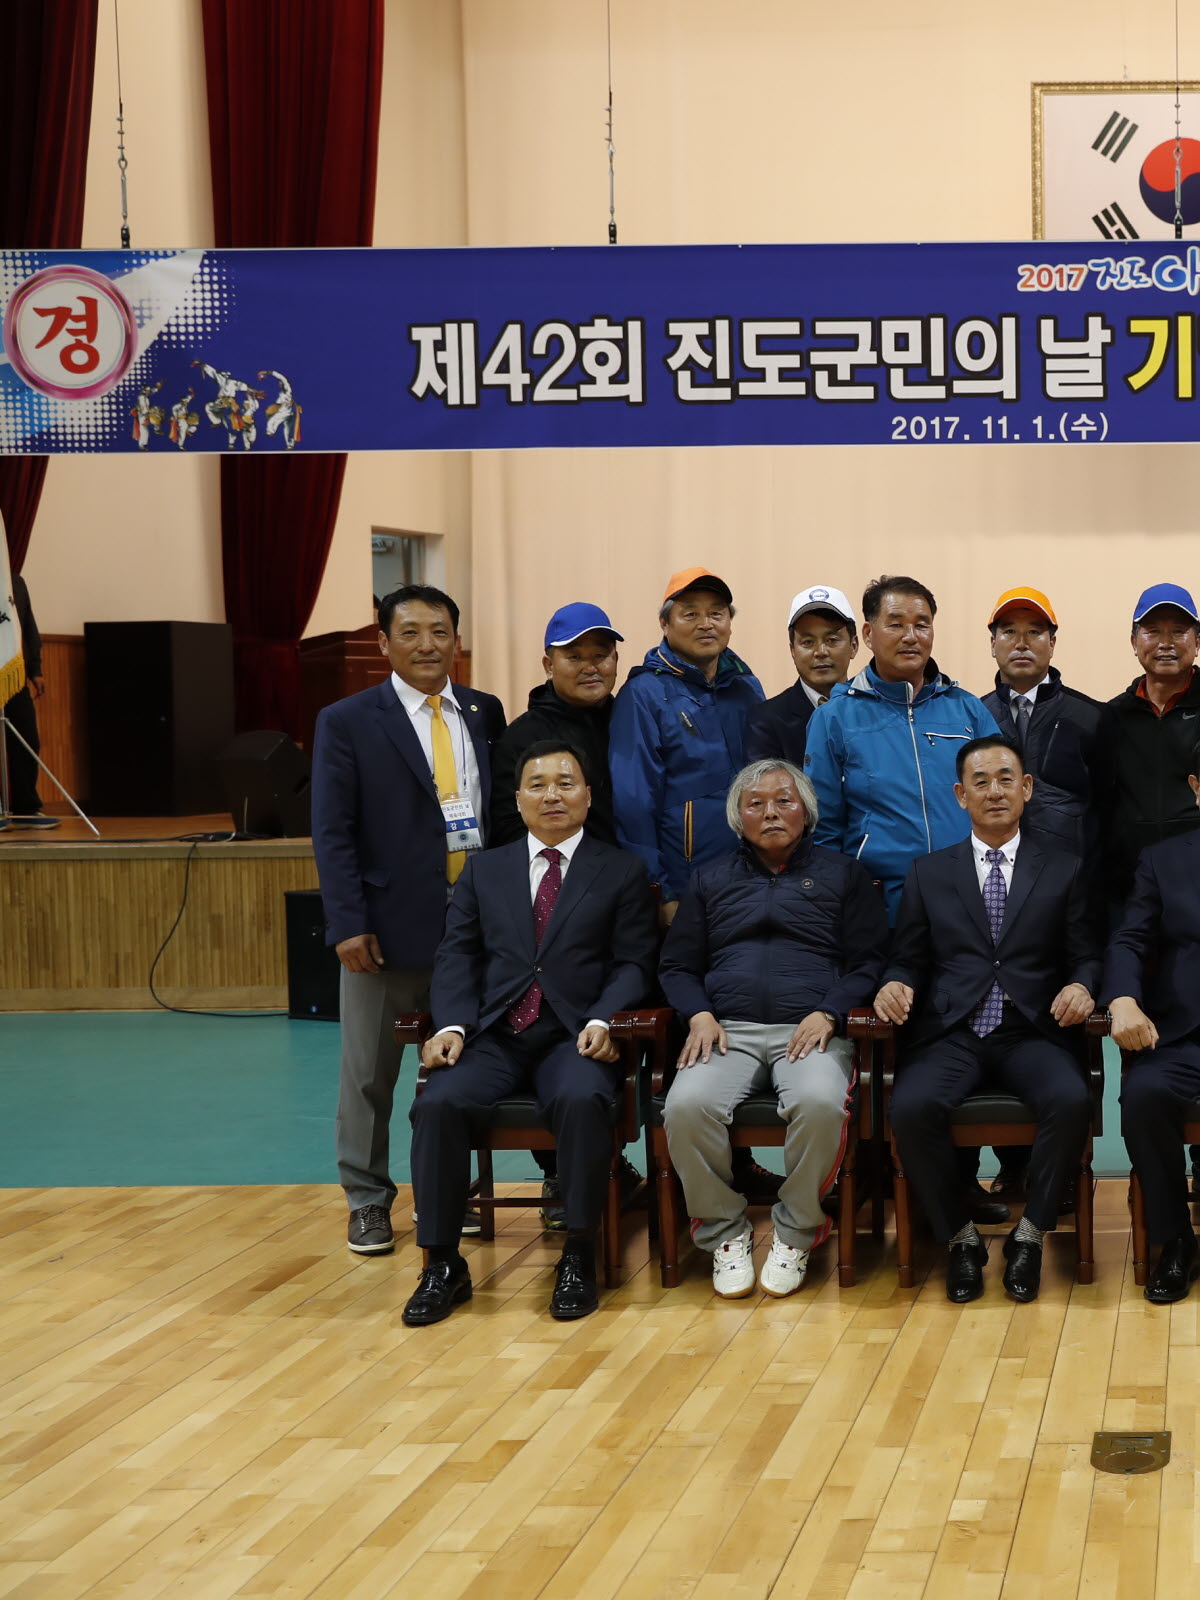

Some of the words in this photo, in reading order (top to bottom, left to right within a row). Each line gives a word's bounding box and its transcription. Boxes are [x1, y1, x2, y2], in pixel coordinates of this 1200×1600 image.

[1018, 265, 1087, 290] 2017
[1090, 257, 1151, 290] 진도
[32, 295, 99, 375] 경
[410, 318, 643, 405] 제42회
[666, 316, 1017, 401] 진도군민의
[1040, 316, 1112, 399] 날
[891, 415, 970, 441] 2017.
[982, 415, 1020, 440] 11.
[1032, 412, 1109, 441] 1.(수)
